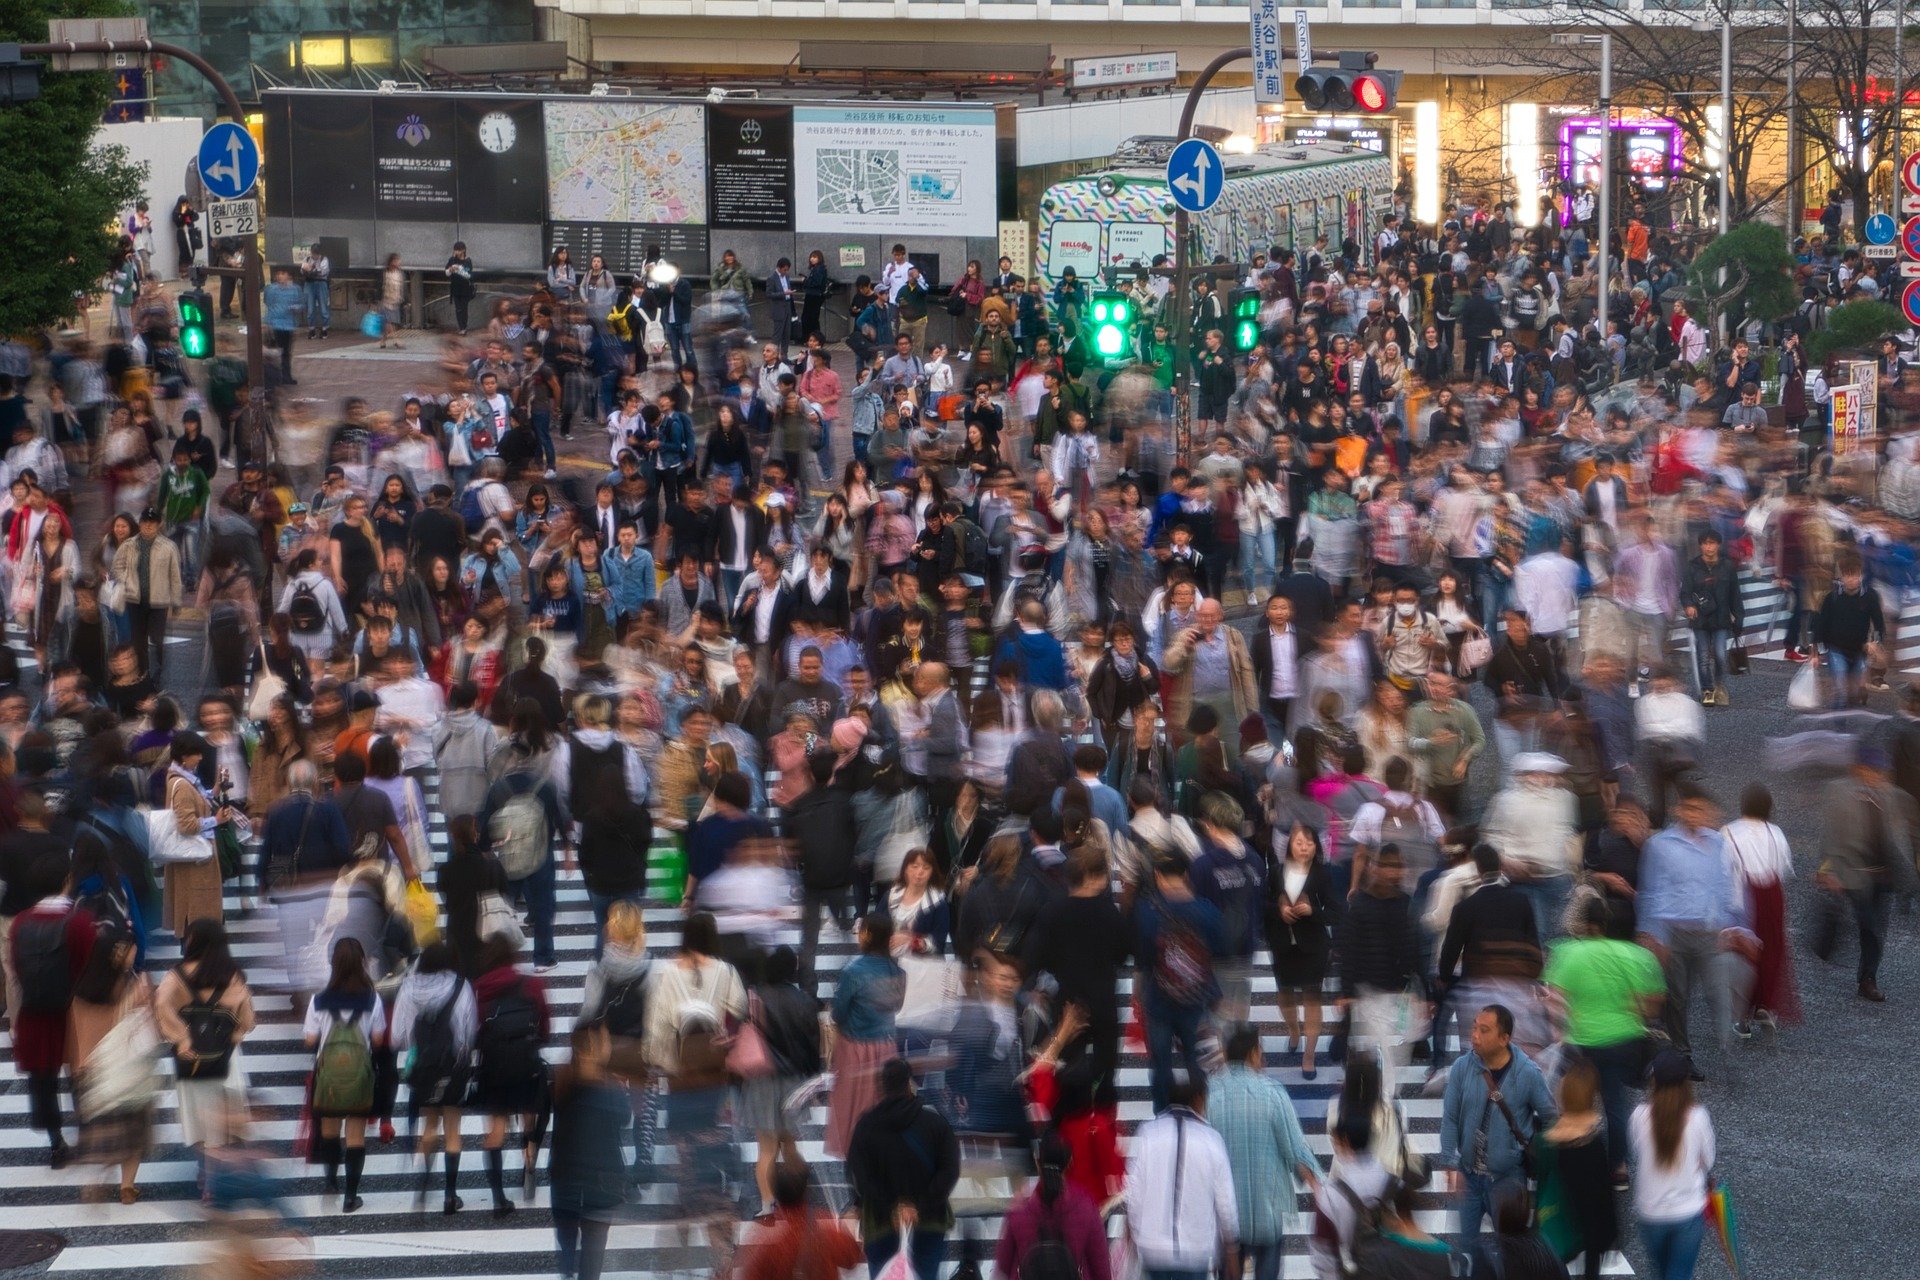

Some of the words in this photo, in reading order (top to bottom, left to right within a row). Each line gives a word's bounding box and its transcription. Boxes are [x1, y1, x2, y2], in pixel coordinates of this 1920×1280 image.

[1253, 13, 1262, 57] Shibuya
[1261, 0, 1279, 95] 渋谷駅前
[1256, 61, 1264, 83] Sta.
[493, 112, 503, 120] 12
[844, 112, 885, 122] 渋谷区役所
[888, 112, 945, 123] 移転のお知らせ
[1639, 127, 1656, 136] Dior
[1867, 248, 1894, 256] 歩行者優先
